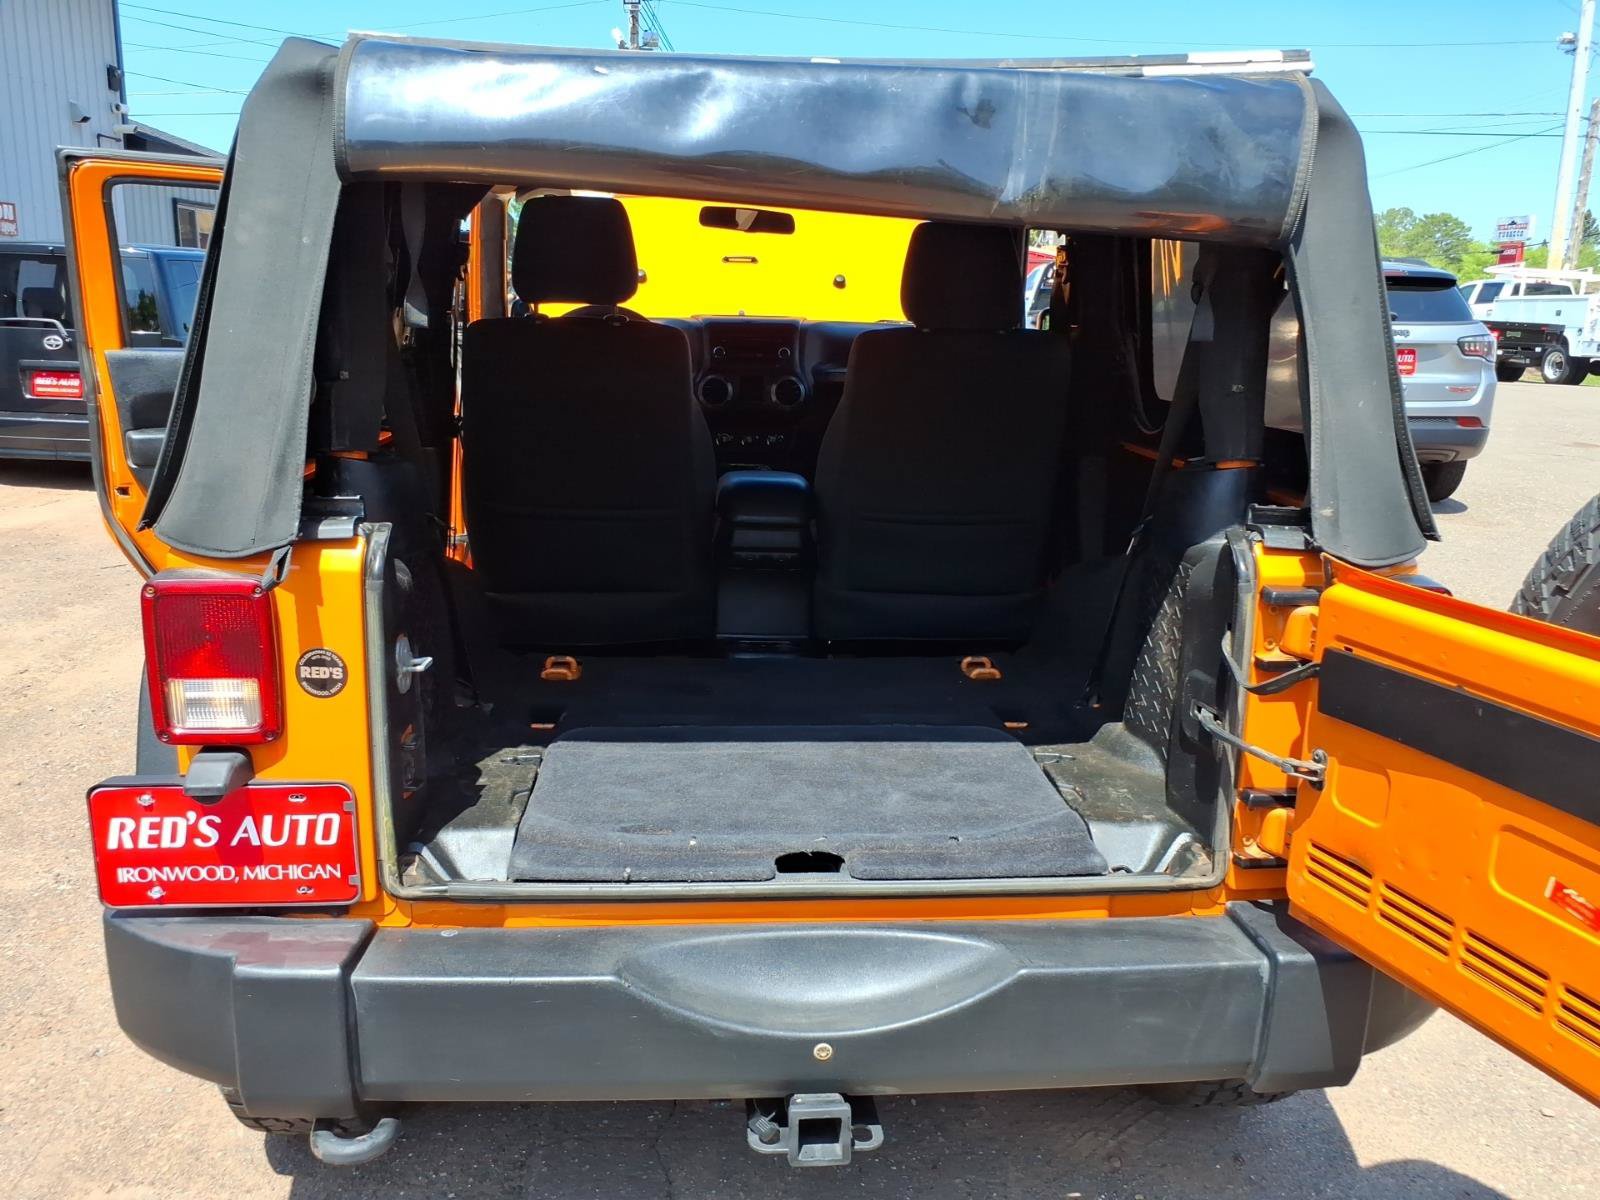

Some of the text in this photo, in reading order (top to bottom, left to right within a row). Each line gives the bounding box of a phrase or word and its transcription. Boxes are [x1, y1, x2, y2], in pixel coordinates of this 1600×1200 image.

[58, 378, 80, 387] AUTO
[300, 665, 344, 680] RED'S
[106, 810, 341, 850] RED'S AUTO
[117, 864, 342, 884] IRONWOOD, MICHIGAN
